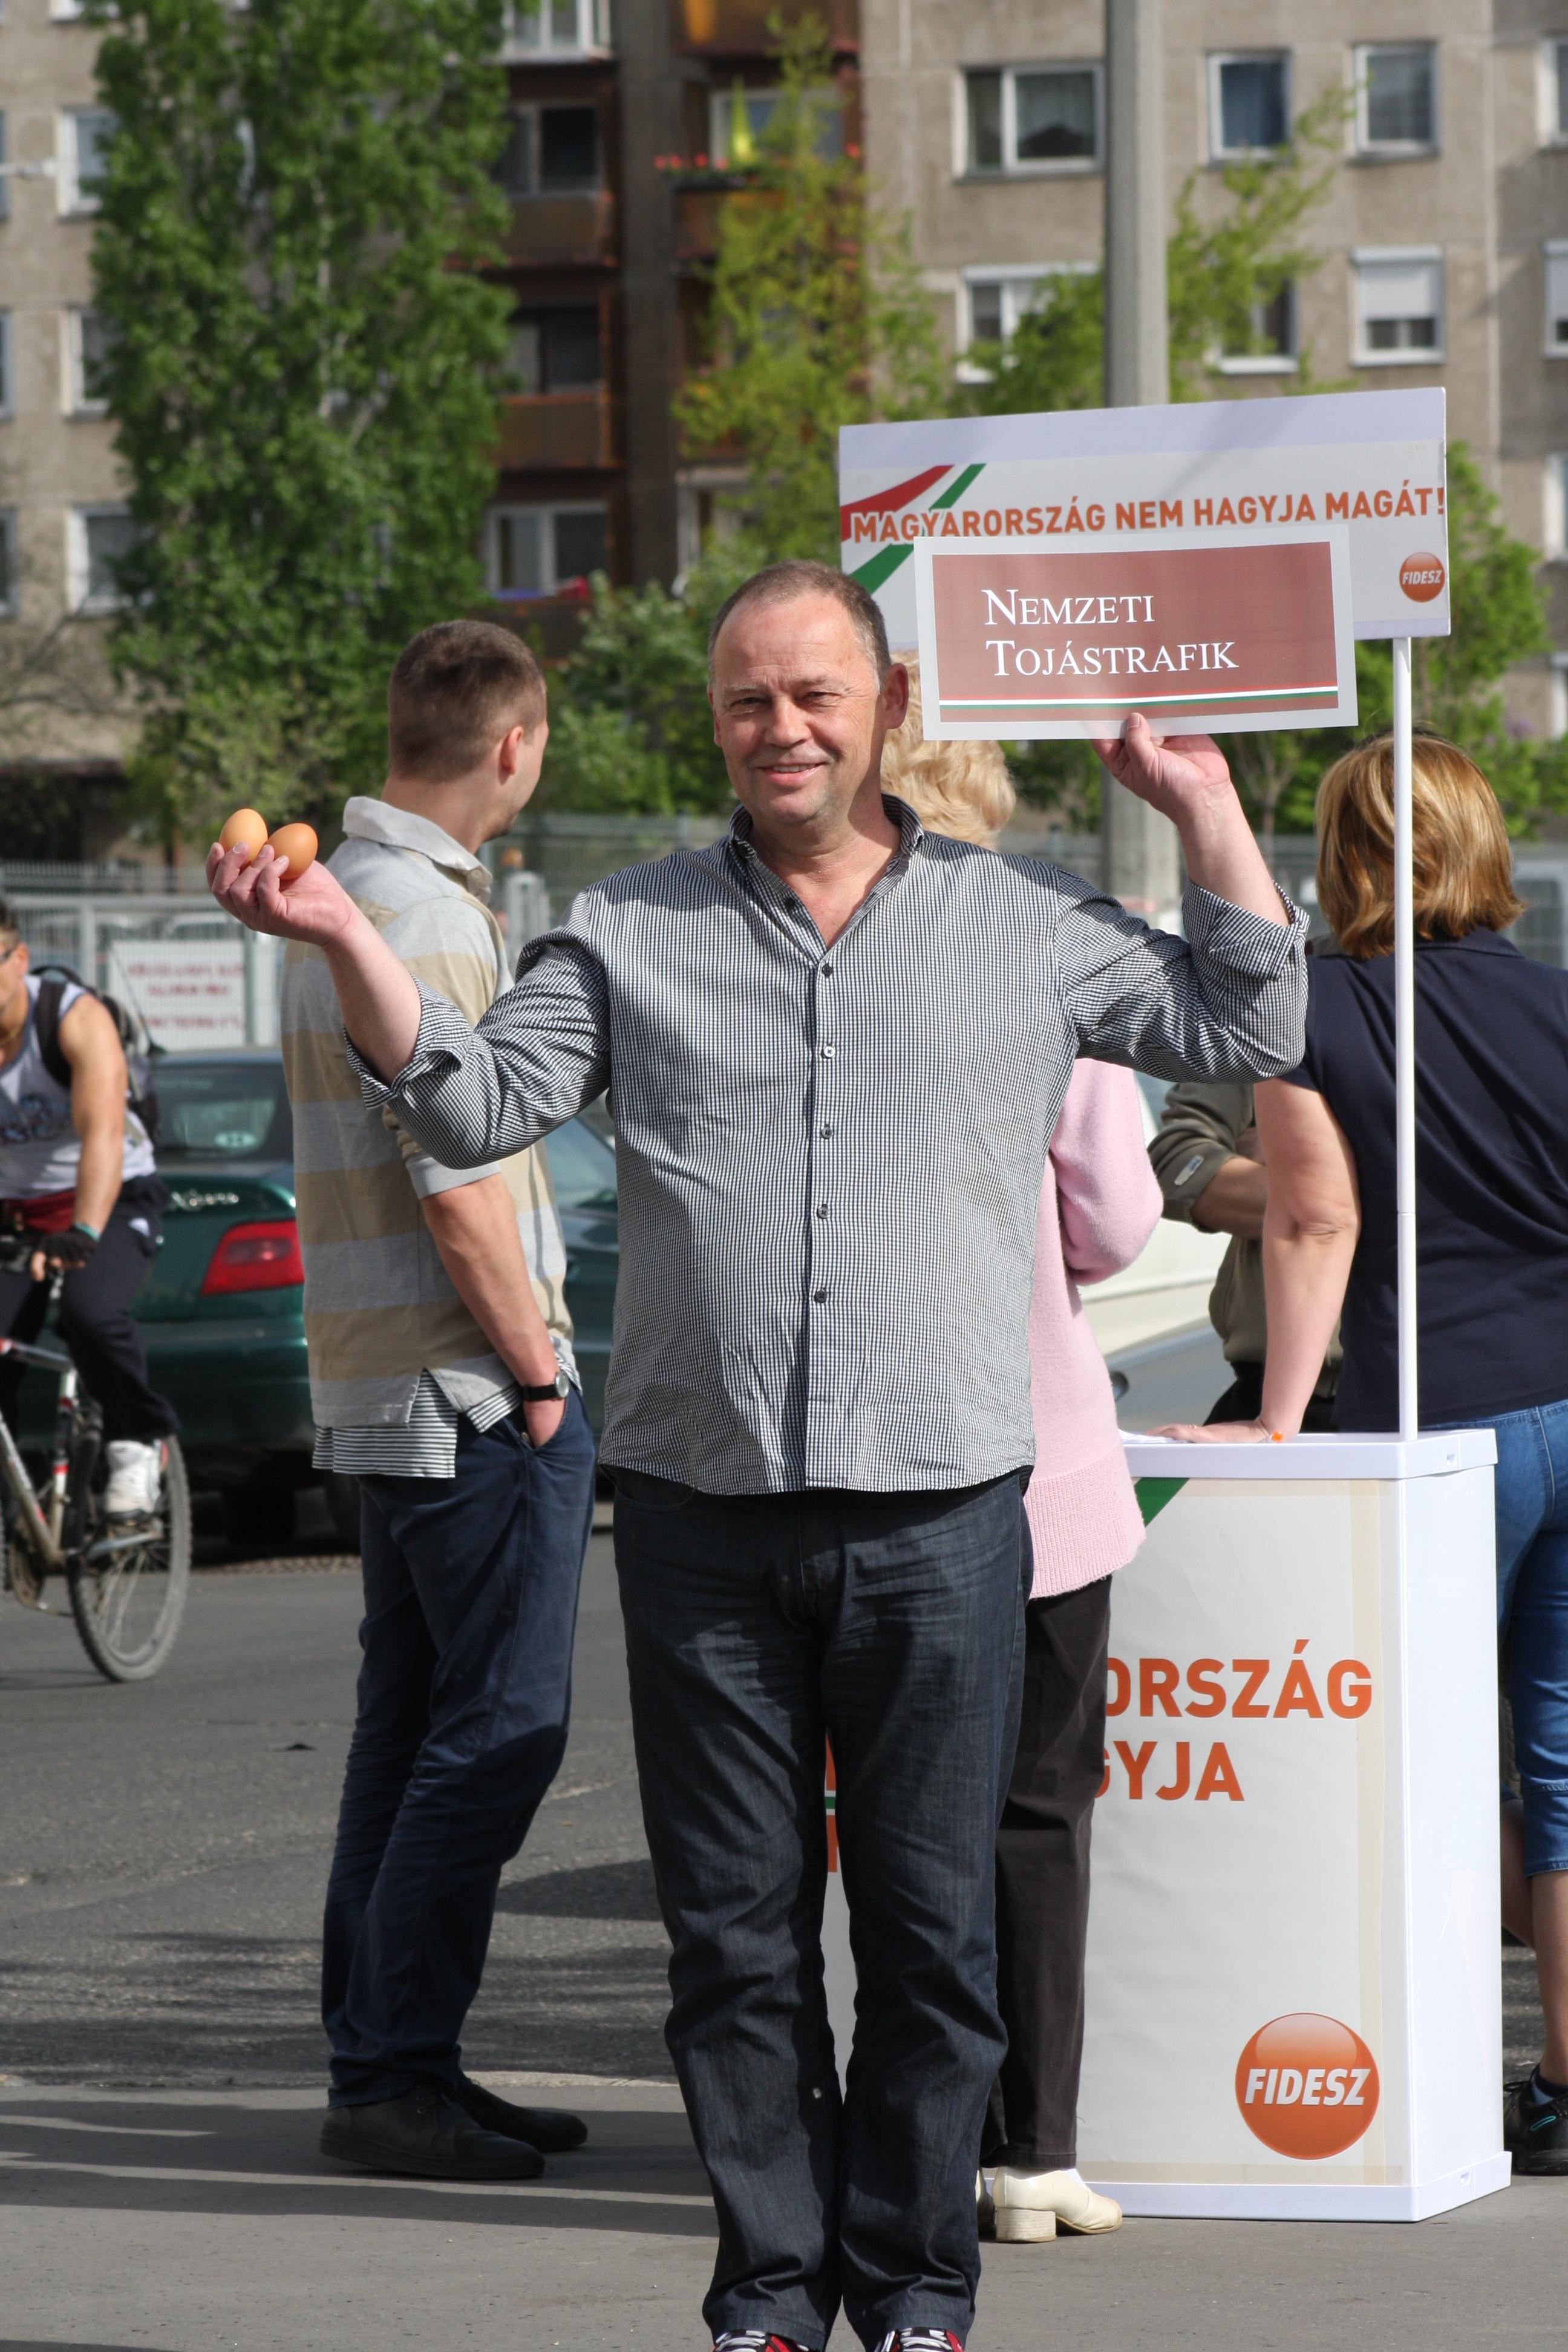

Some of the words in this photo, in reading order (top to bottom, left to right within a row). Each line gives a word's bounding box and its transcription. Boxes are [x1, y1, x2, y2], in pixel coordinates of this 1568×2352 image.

[854, 495, 1105, 543] MAGYARORSZÁG
[1116, 500, 1183, 530] NEM
[1194, 494, 1316, 526] HAGYJA
[1325, 480, 1444, 520] MAGÁT!
[1402, 570, 1442, 585] FIDESZ
[1094, 1740, 1245, 1802] YJA
[1244, 2068, 1371, 2106] FIDESZ
